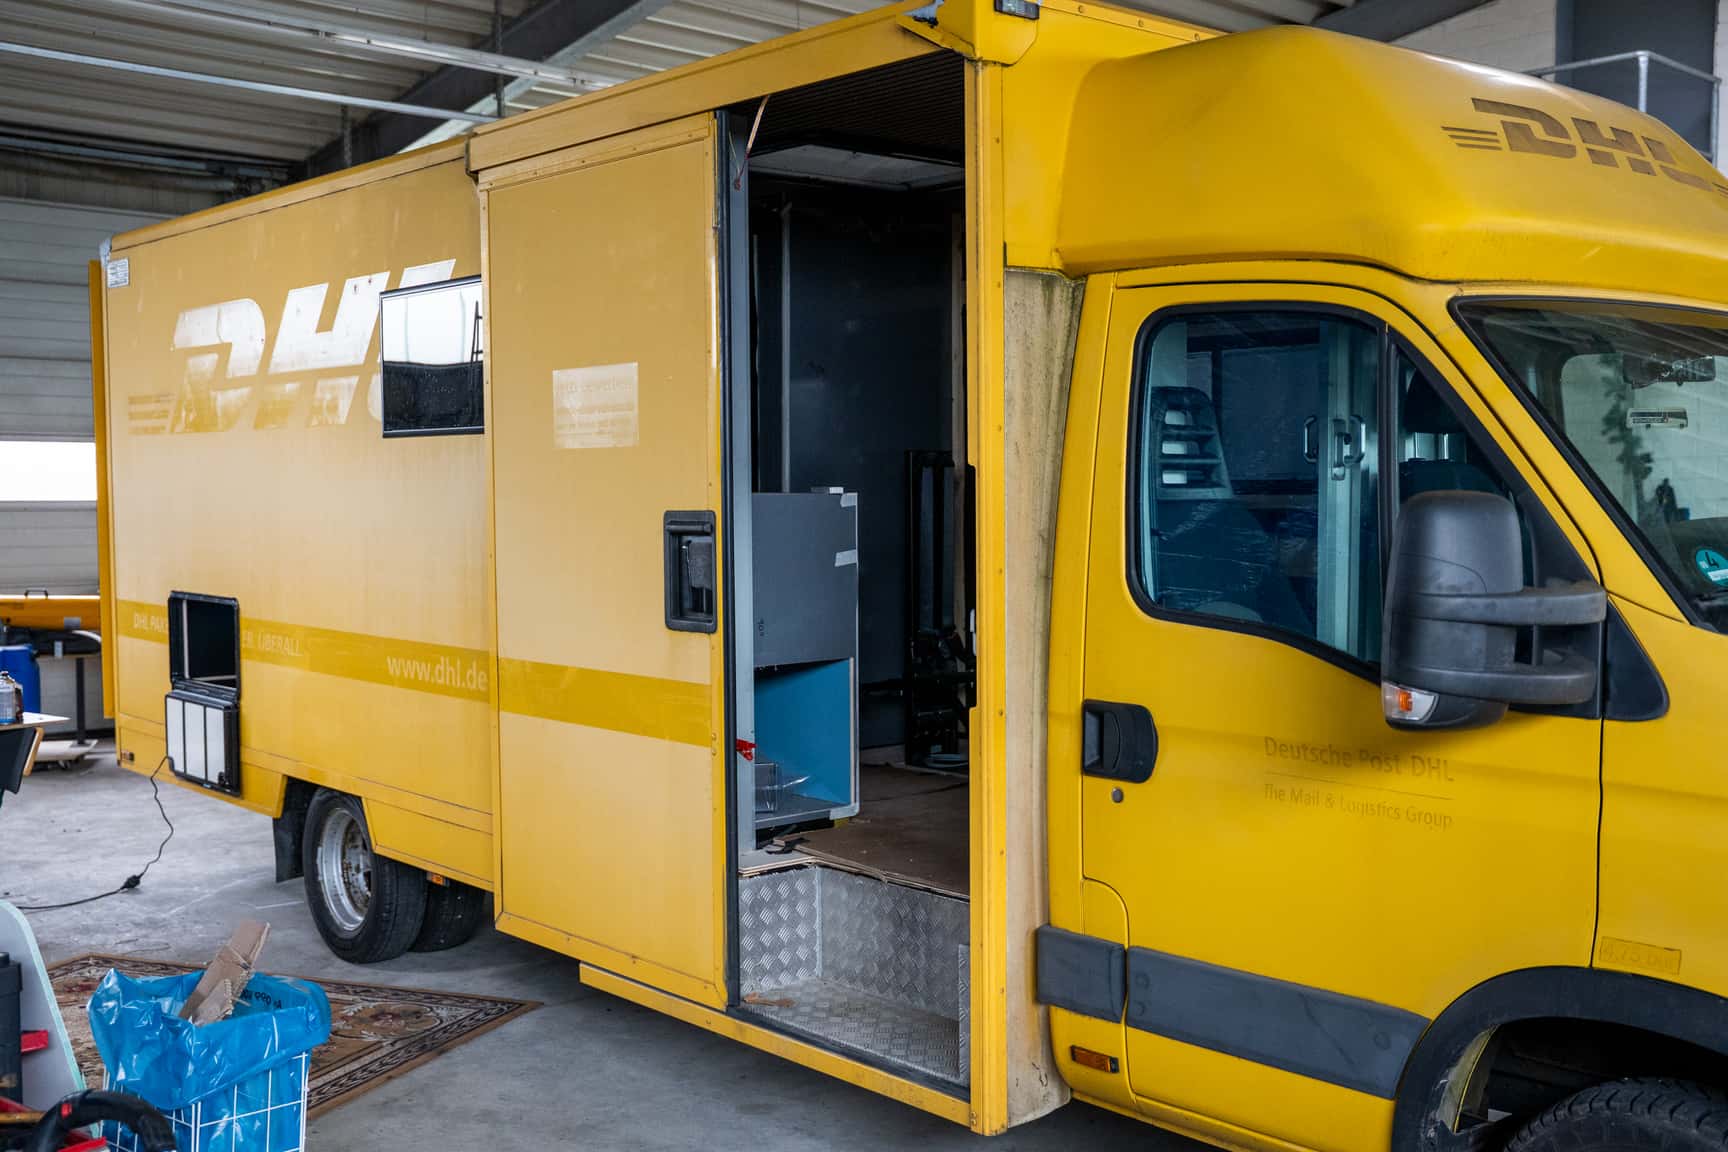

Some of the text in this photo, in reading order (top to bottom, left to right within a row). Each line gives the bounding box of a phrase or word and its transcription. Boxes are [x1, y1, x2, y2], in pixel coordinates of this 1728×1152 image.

[1471, 98, 1714, 192] DHL
[386, 655, 489, 691] www.dhl.de
[1264, 735, 1455, 783] Deutsche Post DHL
[1264, 783, 1286, 802] The
[1290, 786, 1320, 809] Mail
[1325, 792, 1337, 809] &
[1406, 806, 1453, 832] Group
